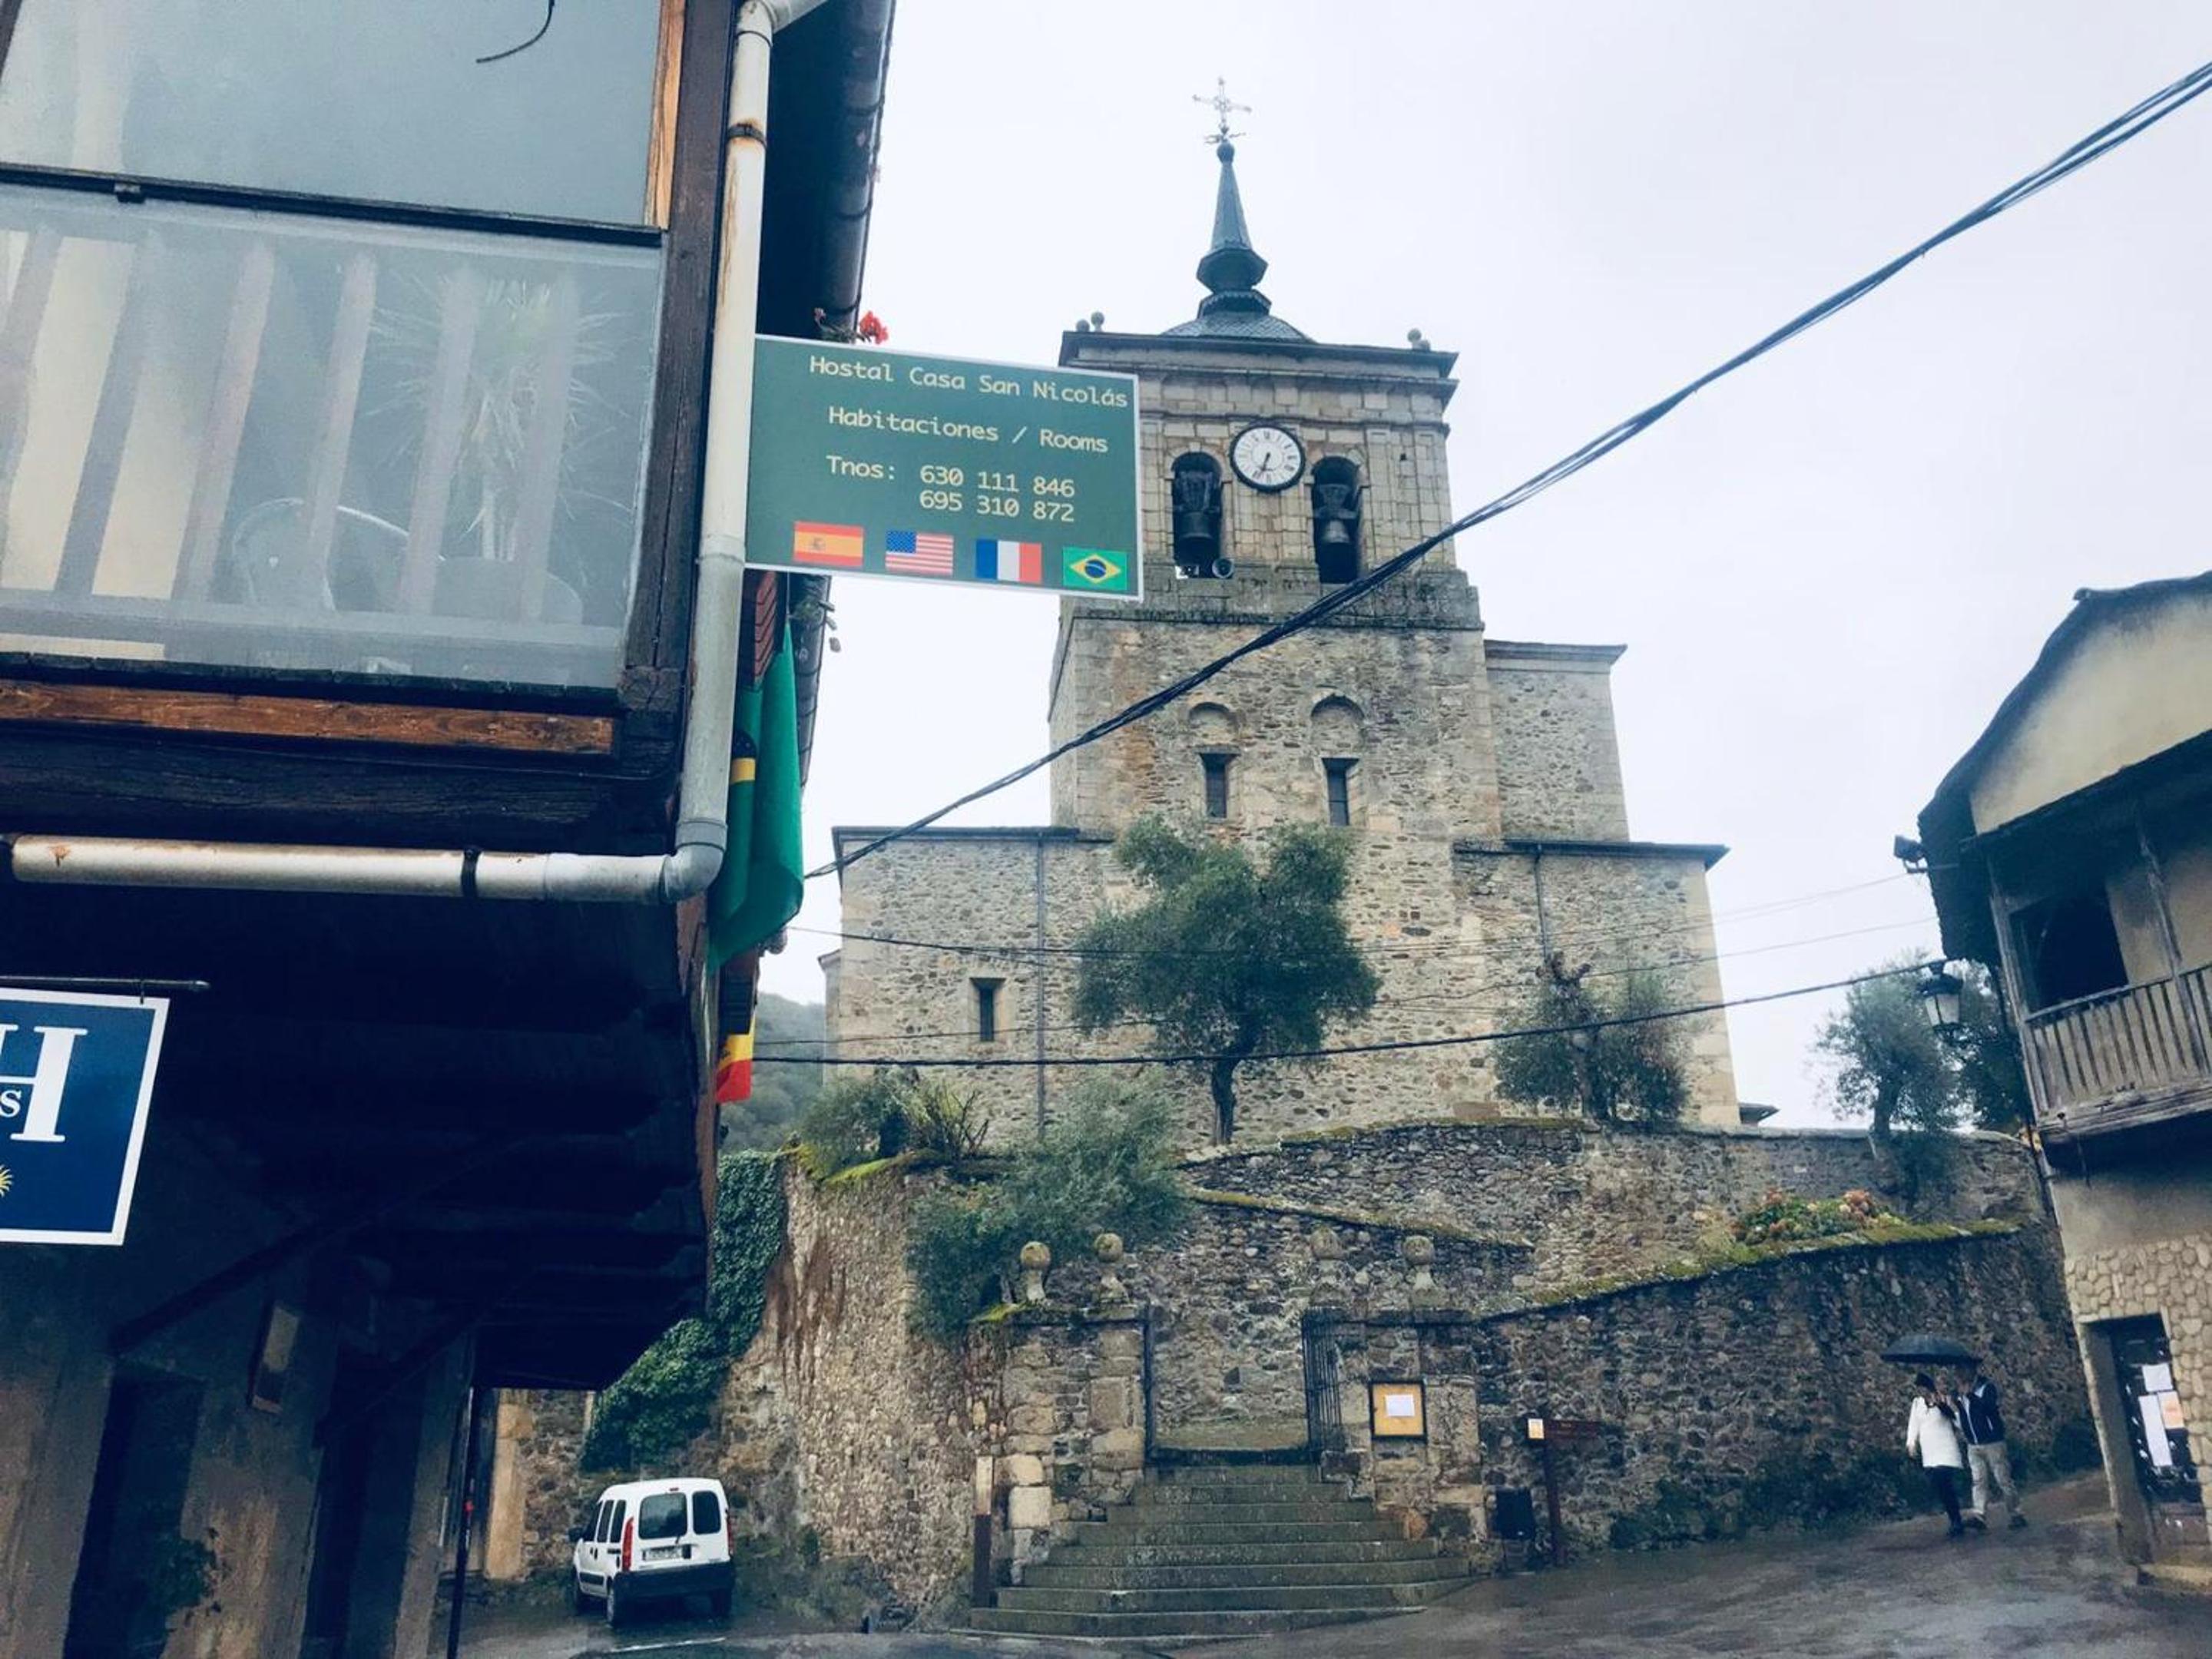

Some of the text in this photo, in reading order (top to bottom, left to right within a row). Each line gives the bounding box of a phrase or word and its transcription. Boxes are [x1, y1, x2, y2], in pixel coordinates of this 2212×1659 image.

[810, 356, 1128, 408] Hostal Casa San Nicolás
[830, 406, 1108, 452] Habitaciones / Rooms
[826, 455, 1075, 498] Tnos: 630 111 846
[919, 489, 1075, 522] 695 310 872
